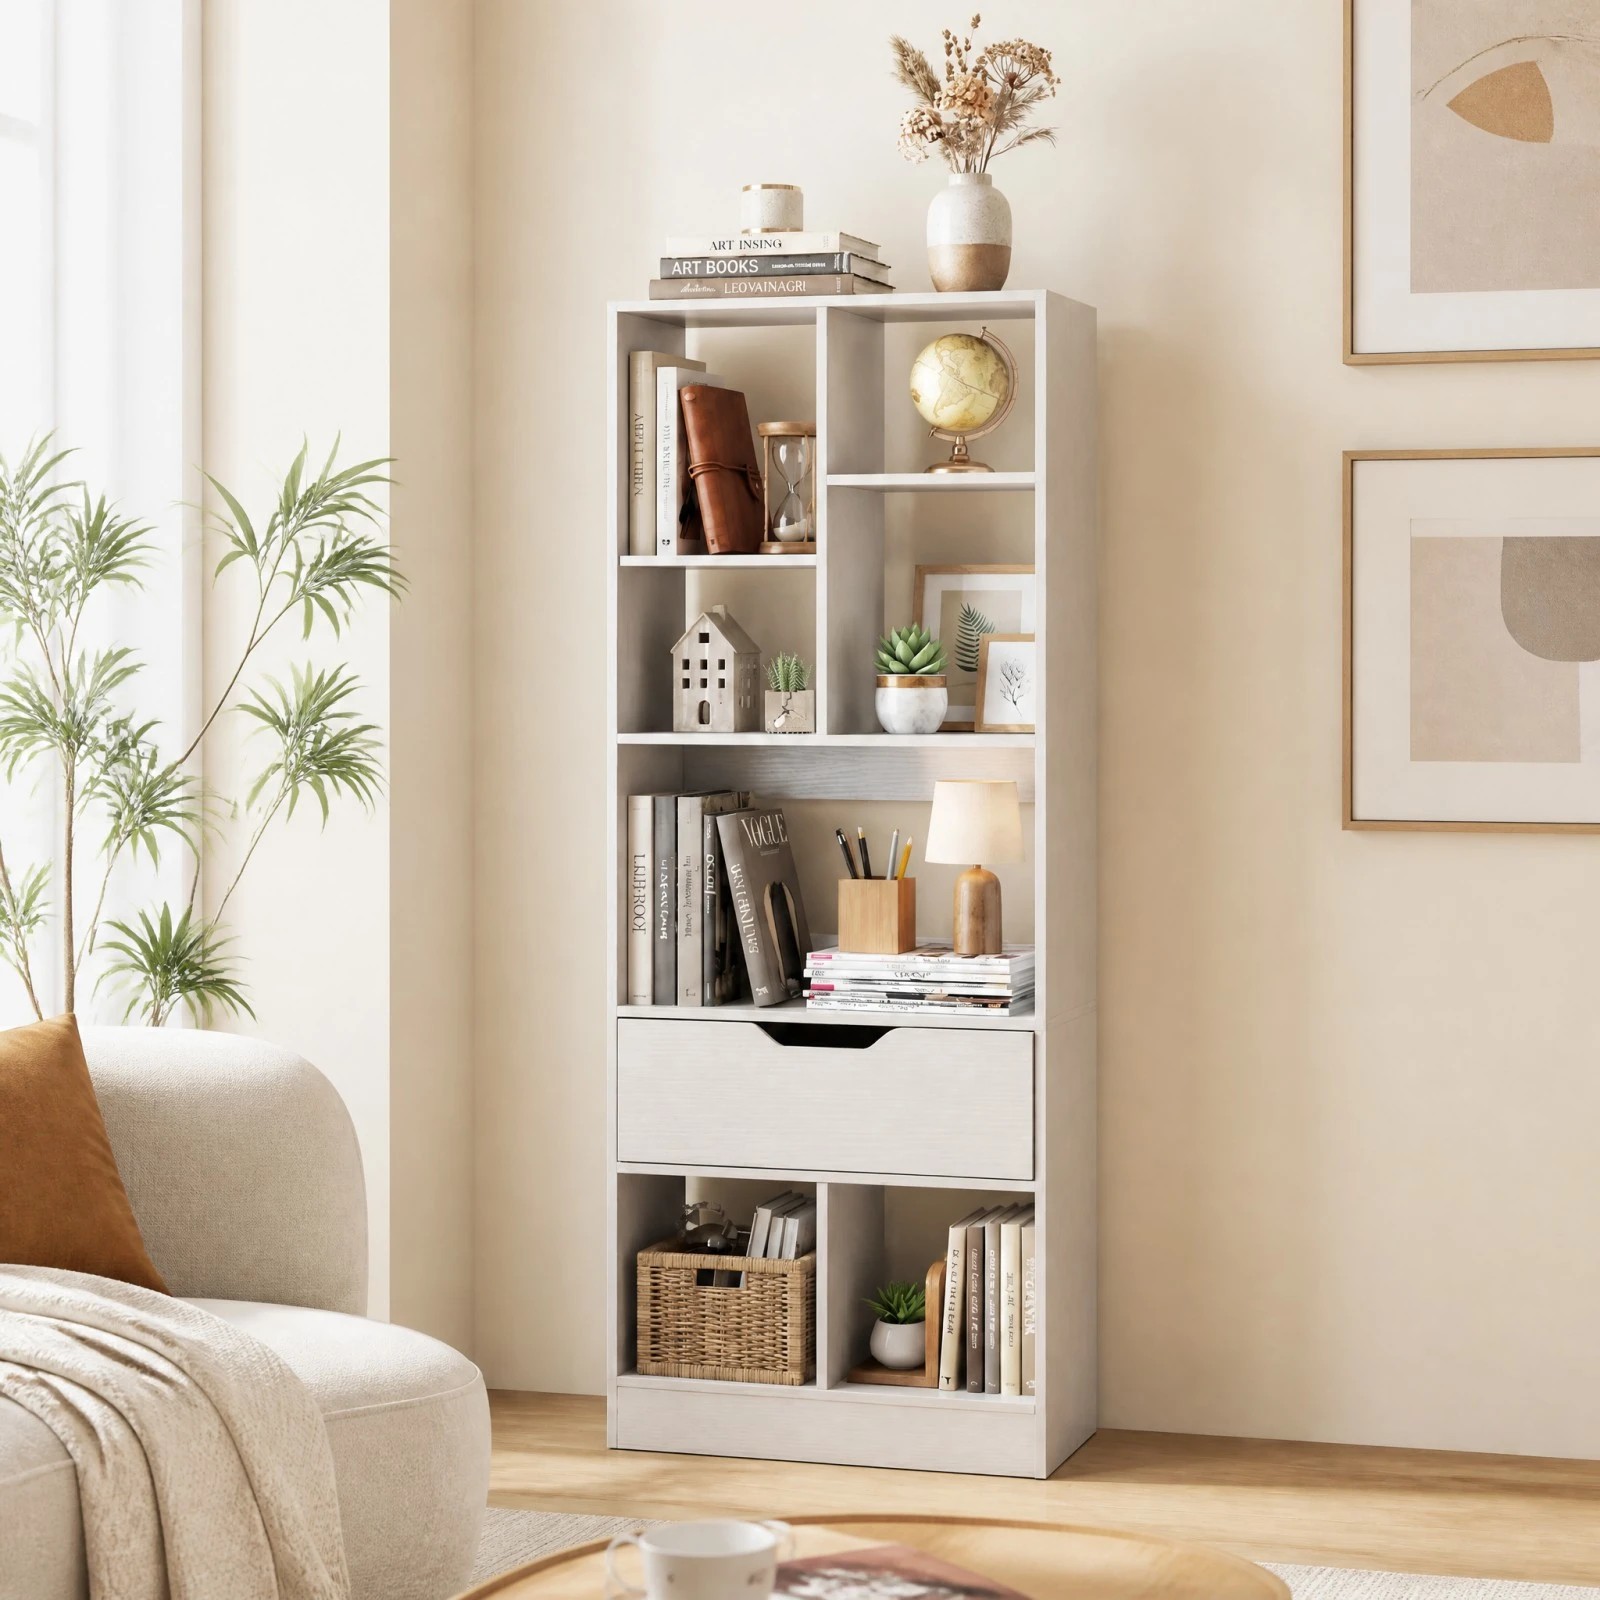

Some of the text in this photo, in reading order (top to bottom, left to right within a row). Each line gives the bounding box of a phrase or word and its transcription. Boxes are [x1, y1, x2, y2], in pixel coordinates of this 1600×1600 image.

[709, 239, 782, 251] ART INSING
[671, 260, 702, 275] ART
[706, 259, 759, 274] BOOKS
[740, 813, 788, 849] VOGUE
